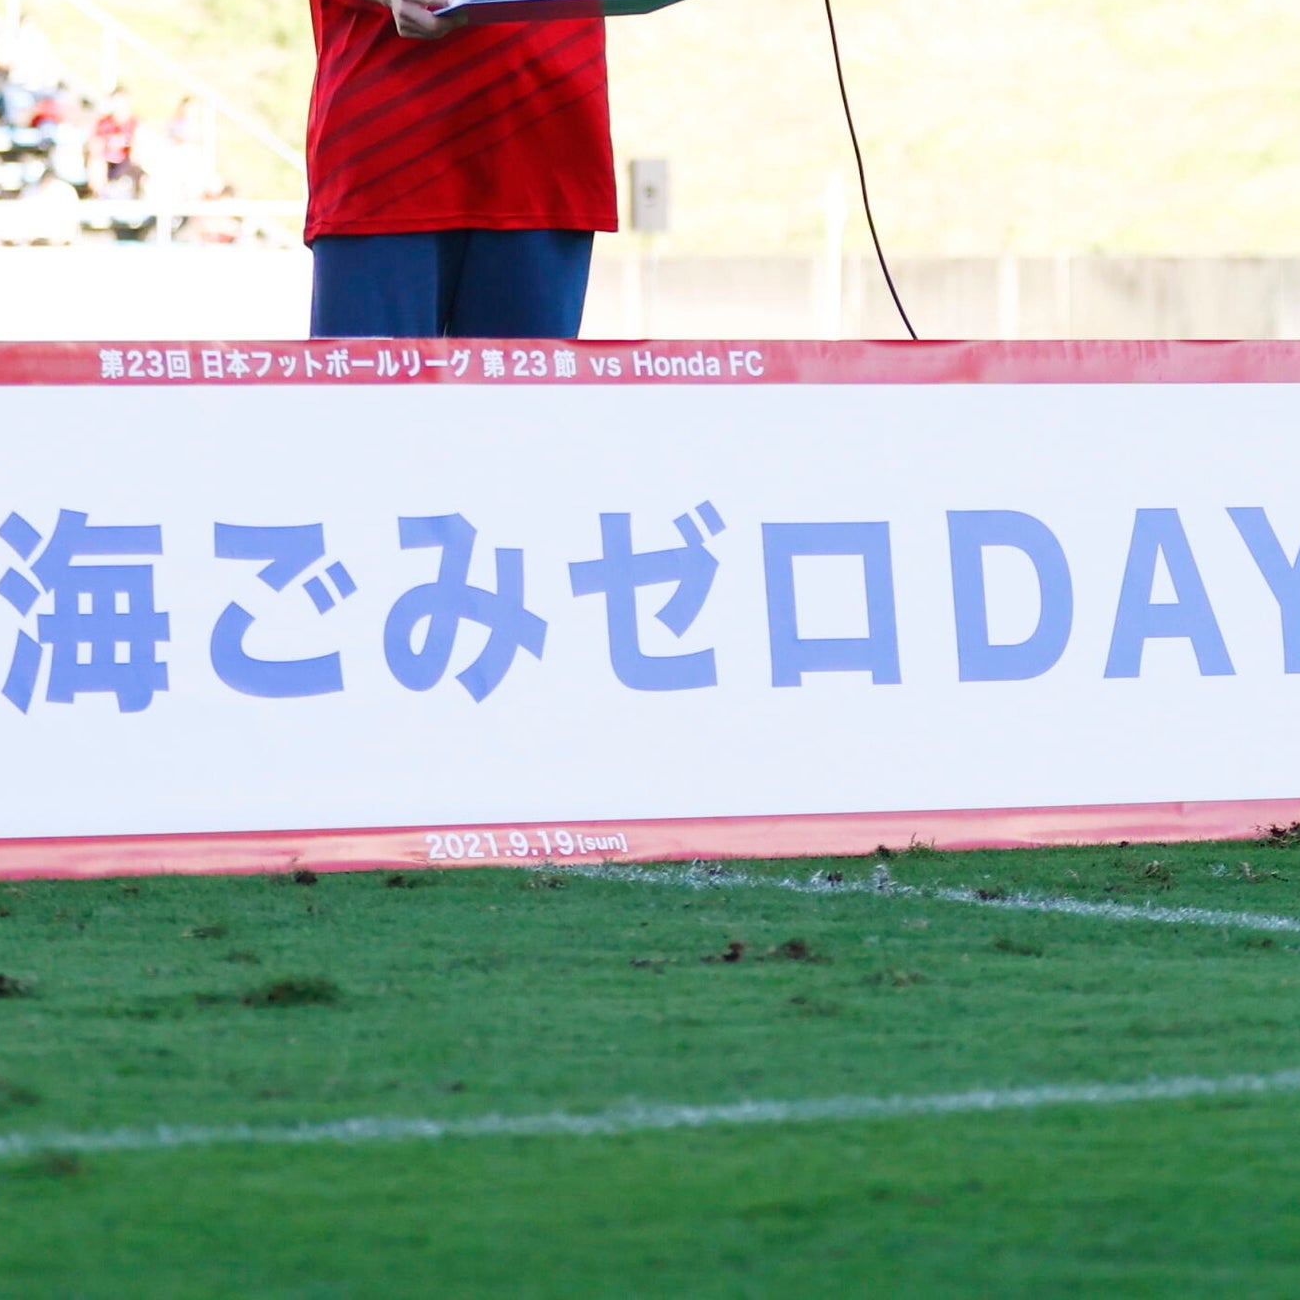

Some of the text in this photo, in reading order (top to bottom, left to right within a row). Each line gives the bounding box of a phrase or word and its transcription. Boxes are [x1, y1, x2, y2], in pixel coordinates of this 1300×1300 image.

[98, 348, 191, 379] 第23回
[200, 347, 470, 379] 日本フットボールリーグ
[589, 356, 622, 377] vs
[631, 351, 721, 378] Honda
[727, 351, 764, 377] FC
